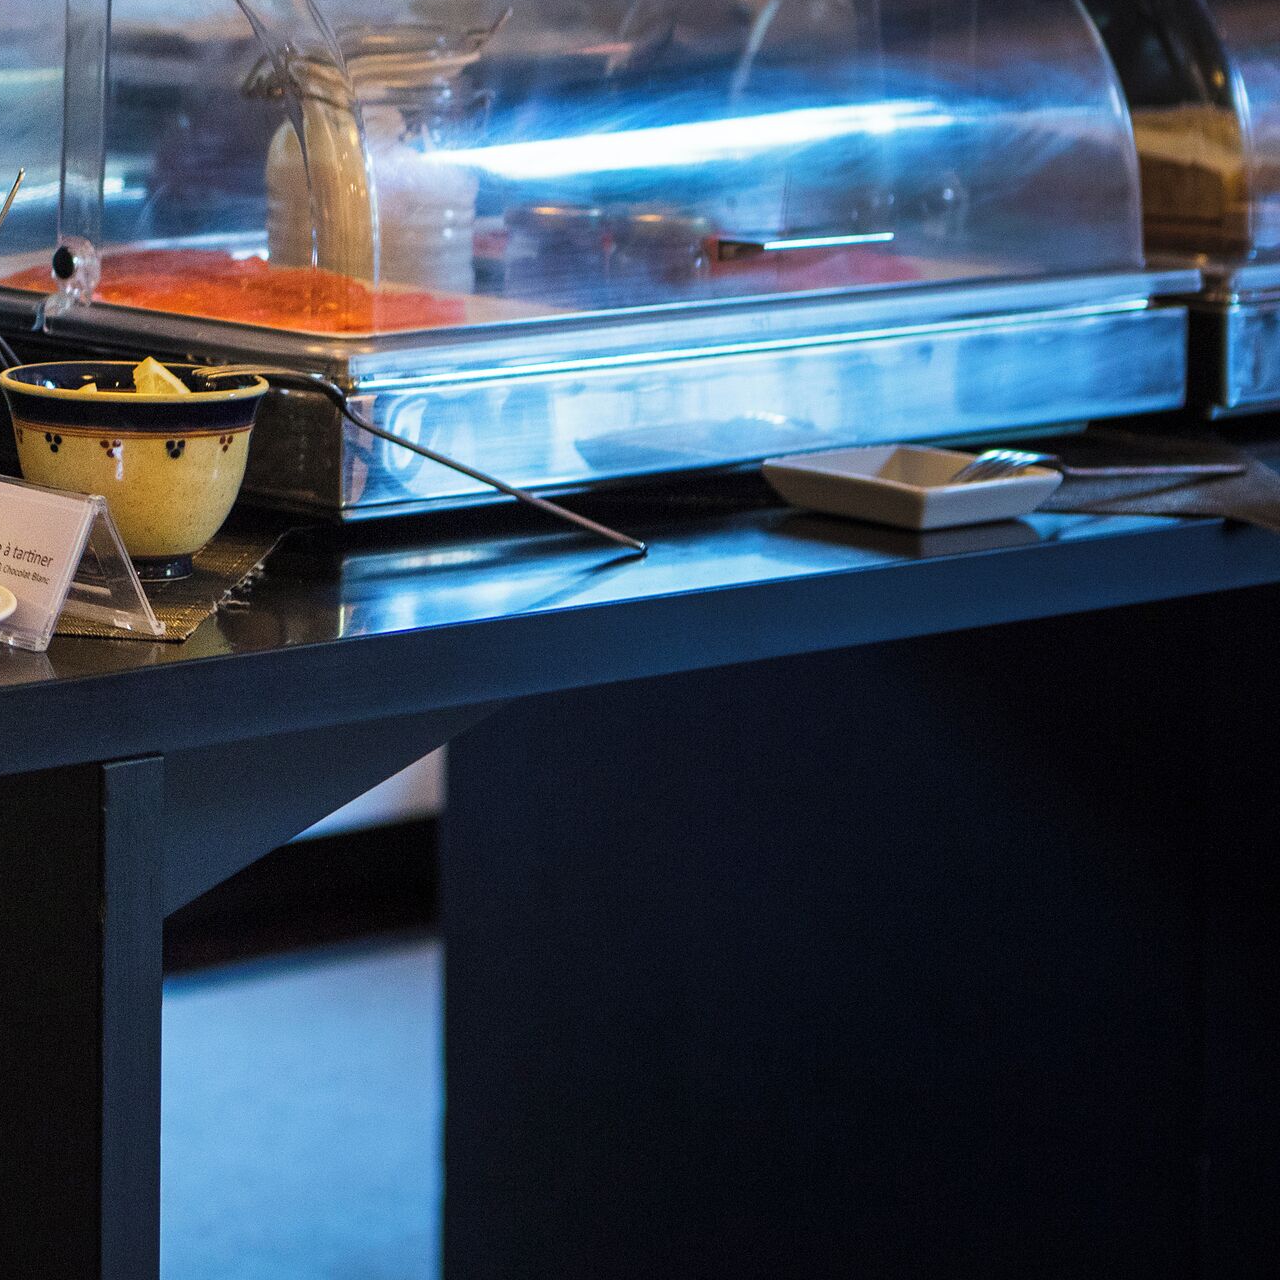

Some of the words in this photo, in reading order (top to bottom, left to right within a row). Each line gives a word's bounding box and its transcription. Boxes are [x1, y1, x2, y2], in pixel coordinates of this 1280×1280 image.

[3, 542, 11, 557] à
[12, 546, 54, 568] tartiner
[3, 564, 31, 580] Chocolat
[31, 571, 51, 586] Blanc
